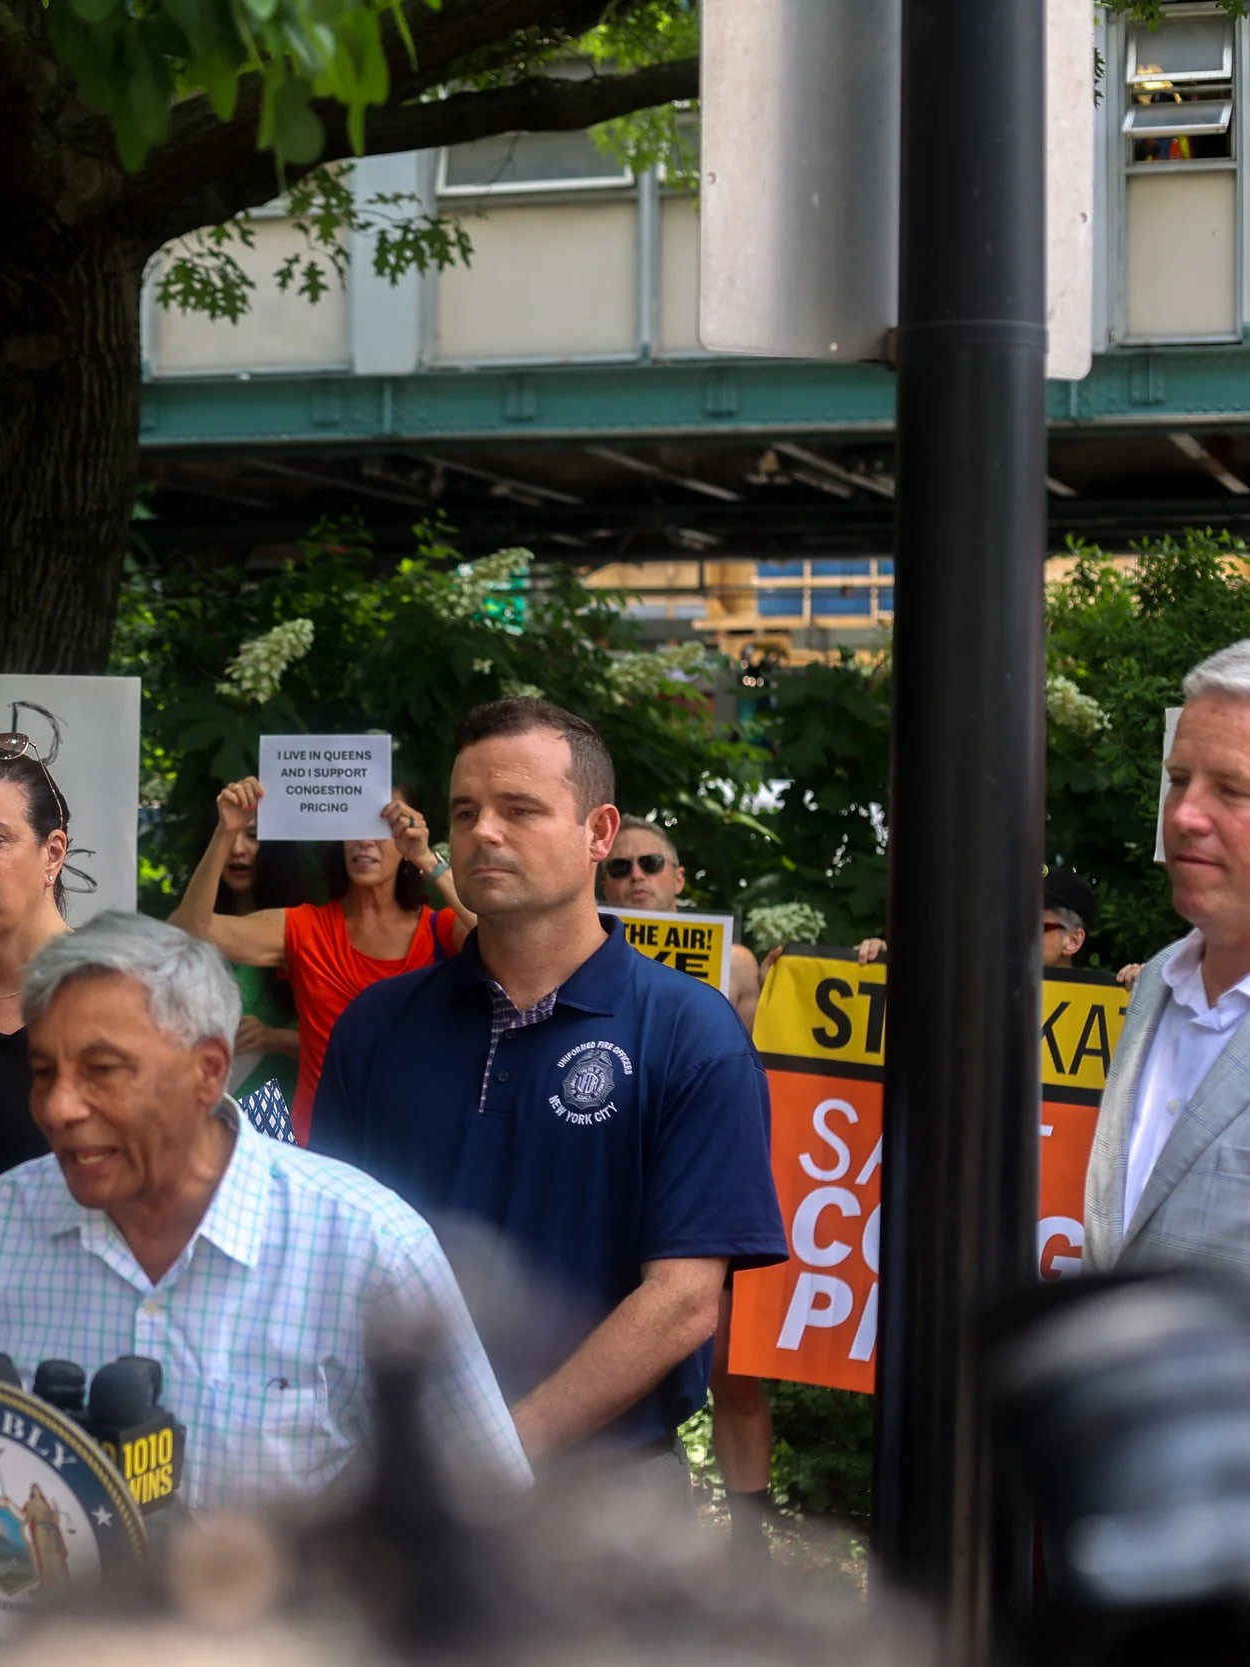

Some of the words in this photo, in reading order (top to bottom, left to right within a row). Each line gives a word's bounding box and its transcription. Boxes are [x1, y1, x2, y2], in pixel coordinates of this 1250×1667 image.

[283, 750, 306, 760] LIVE
[309, 750, 321, 760] IN
[323, 750, 372, 762] QUEENS
[281, 768, 306, 778] AND
[314, 768, 367, 778] SUPPORT
[286, 785, 362, 795] CONGESTION
[300, 803, 348, 813] PRICING
[664, 926, 713, 950] AIR!
[557, 1041, 596, 1068] UNIFORMED
[597, 1041, 614, 1051] FIRE
[612, 1046, 633, 1075] OFFICERS
[548, 1094, 567, 1117] NEW
[565, 1110, 593, 1125] YORK
[594, 1101, 618, 1122] CITY
[122, 1427, 173, 1480] 1010
